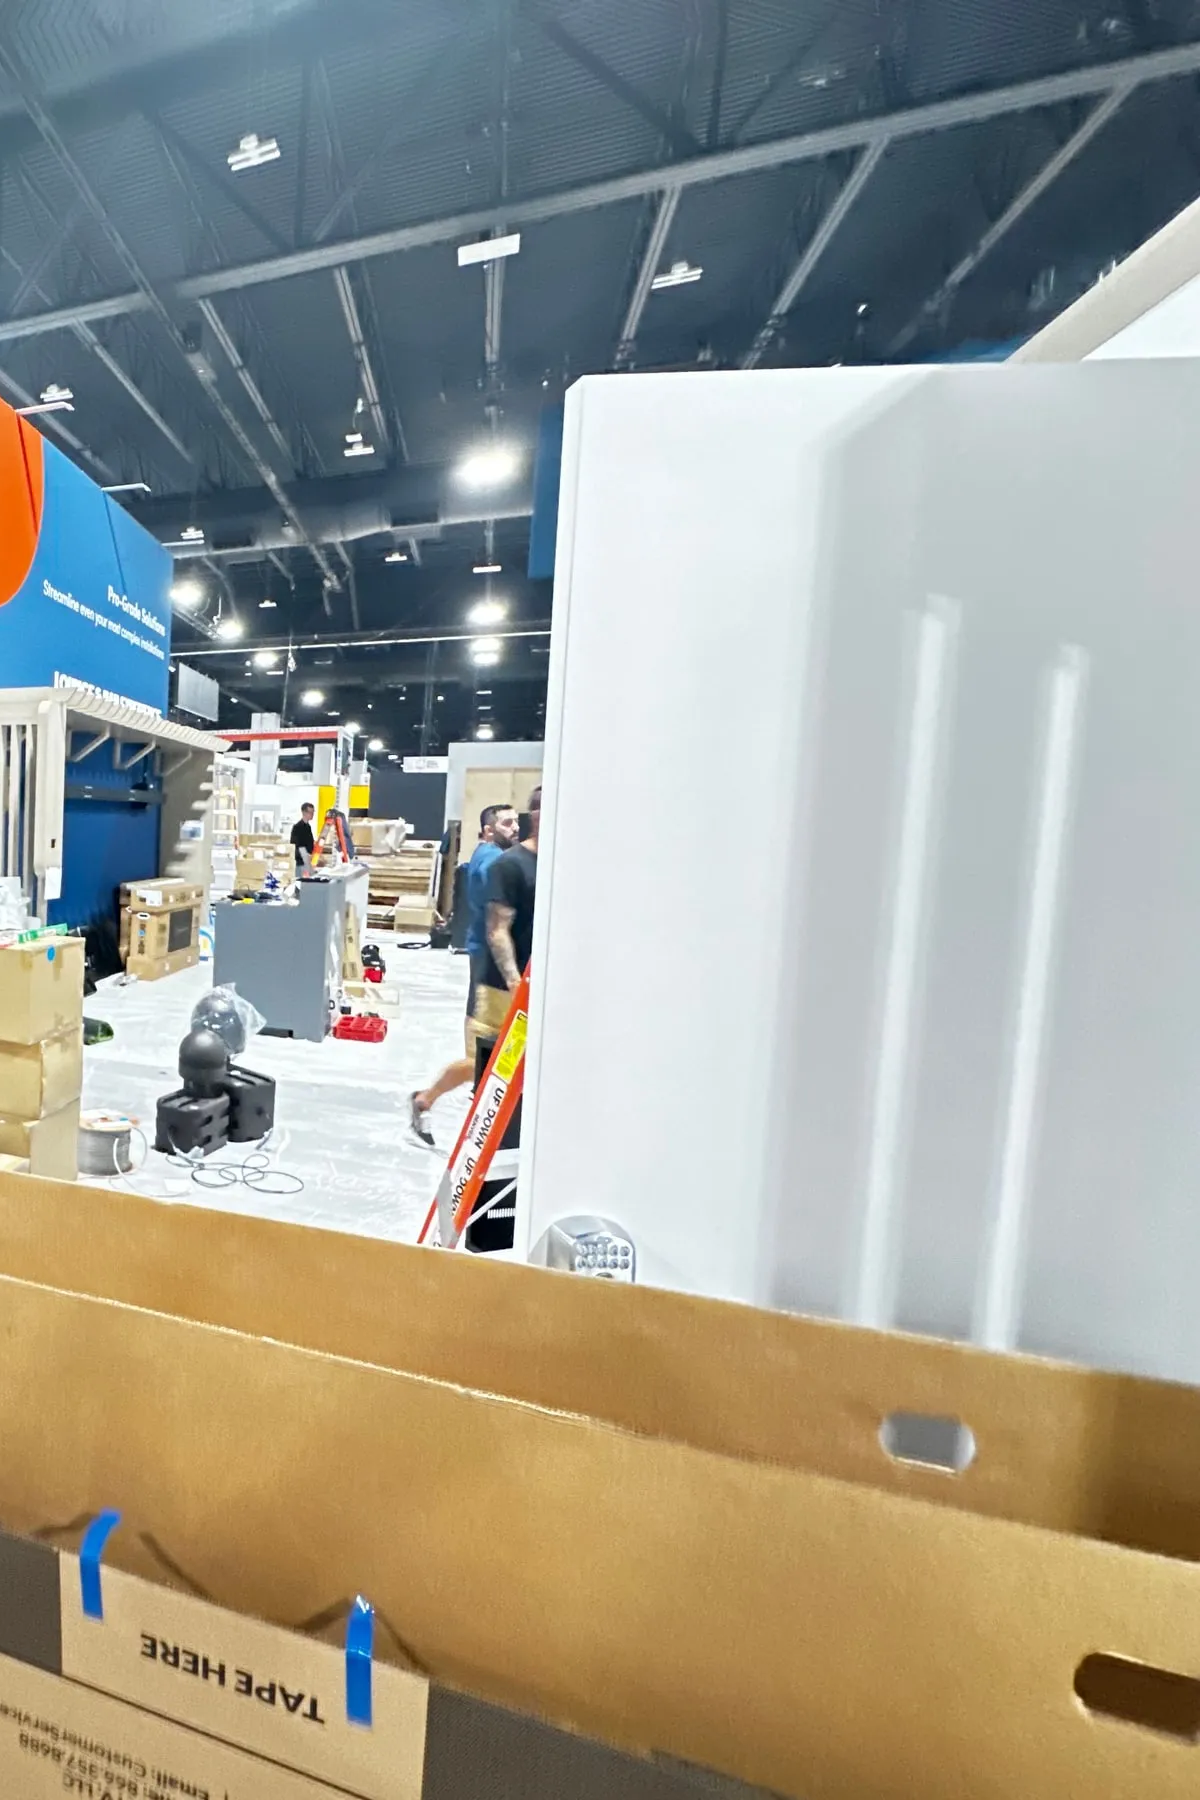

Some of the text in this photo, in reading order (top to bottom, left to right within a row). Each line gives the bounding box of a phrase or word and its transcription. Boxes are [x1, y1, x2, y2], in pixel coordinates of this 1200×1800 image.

[43, 579, 80, 613] Streamline
[80, 604, 95, 621] even
[95, 612, 108, 627] your
[107, 620, 121, 635] most
[107, 584, 166, 637] Pro-Grade Solutions
[474, 1107, 497, 1150] DOWN
[140, 1633, 325, 1725] TAPE HERE
